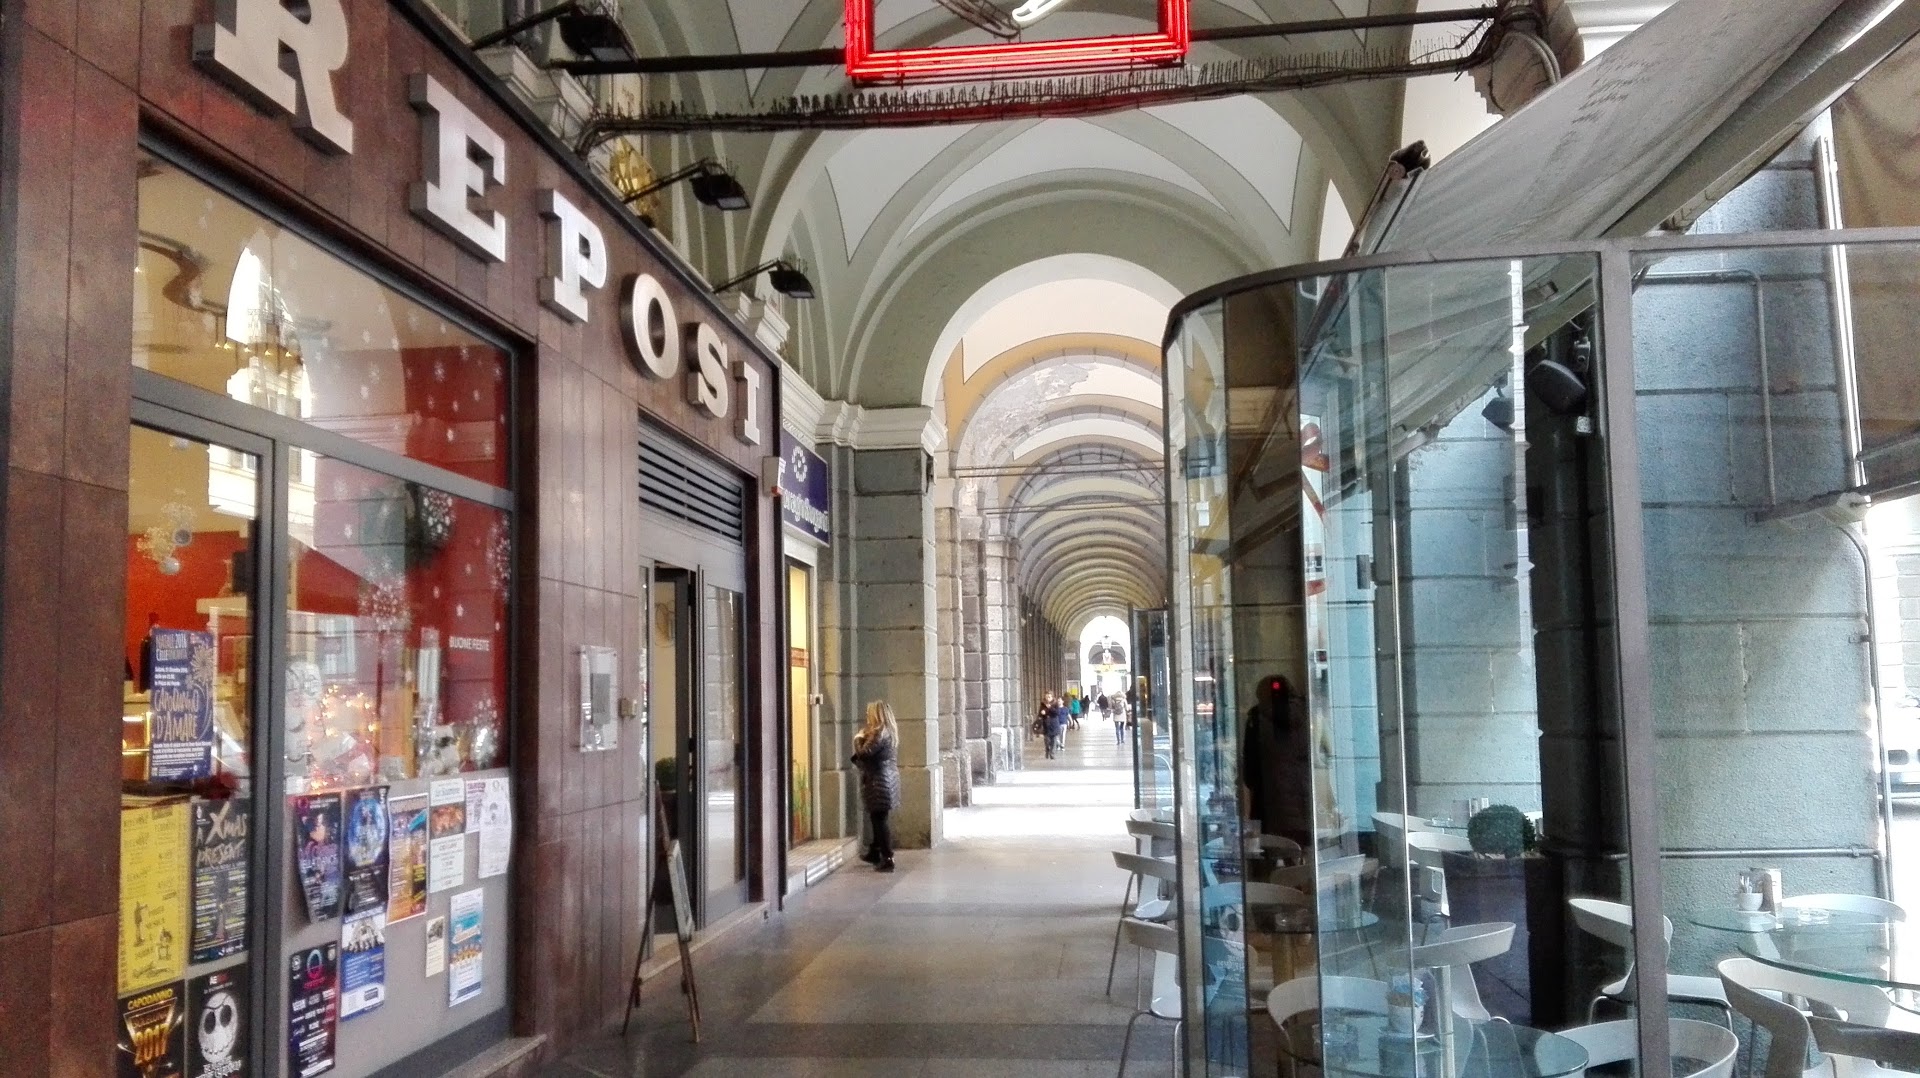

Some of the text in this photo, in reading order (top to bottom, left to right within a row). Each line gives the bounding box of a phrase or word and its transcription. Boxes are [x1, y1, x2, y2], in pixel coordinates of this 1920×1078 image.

[197, 0, 762, 446] REPOSI
[449, 636, 490, 652] BUONE FESTE
[127, 988, 174, 1011] CAPODANNO
[134, 1022, 170, 1066] 2017
